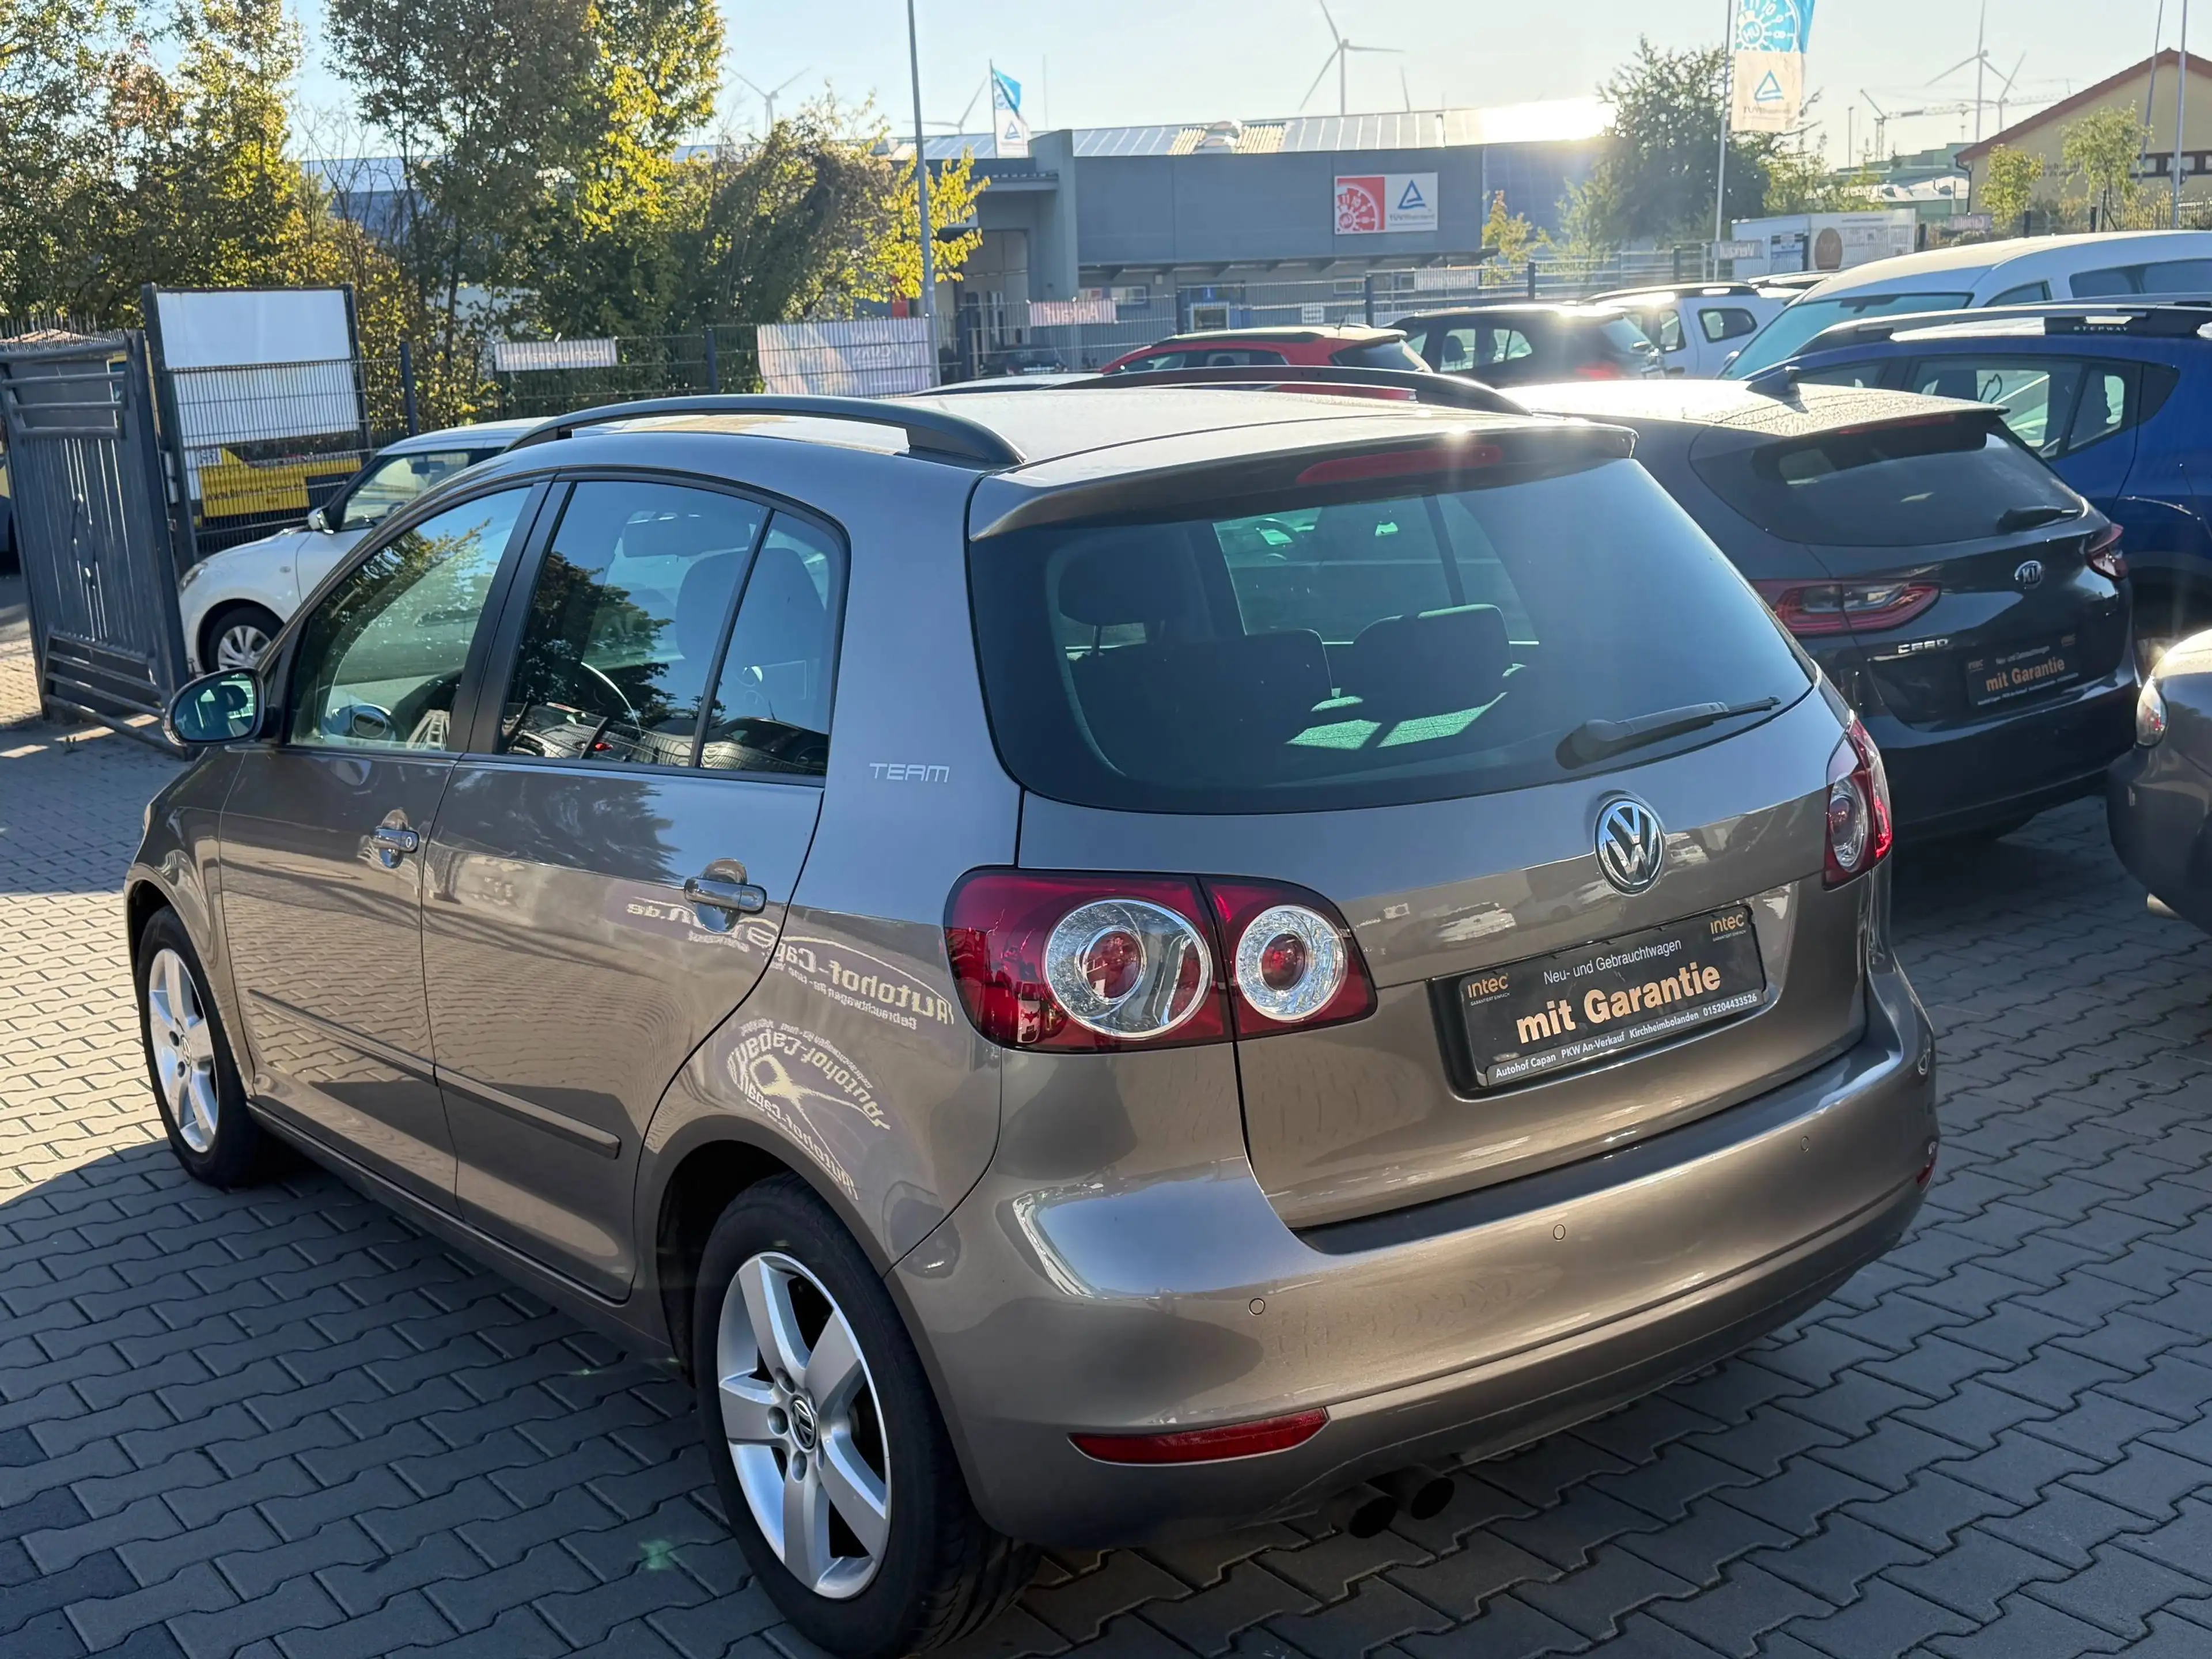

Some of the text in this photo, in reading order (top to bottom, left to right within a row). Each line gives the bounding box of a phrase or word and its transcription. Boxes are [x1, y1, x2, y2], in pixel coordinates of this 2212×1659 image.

[1741, 22, 1760, 42] HU
[1773, 30, 1786, 39] 8
[2022, 566, 2043, 583] KIA
[1985, 672, 2009, 692] mit
[2011, 656, 2066, 685] Garantie
[869, 763, 950, 783] TEAM
[1600, 800, 1660, 888] VW
[1543, 939, 1682, 986] Neu- und Gebrauchtwagen
[1516, 961, 1722, 1044] mit Garantie
[1495, 993, 1758, 1079] Autohof Capan PKW An-Verkauf Kirchheimbolanden 015204433526
